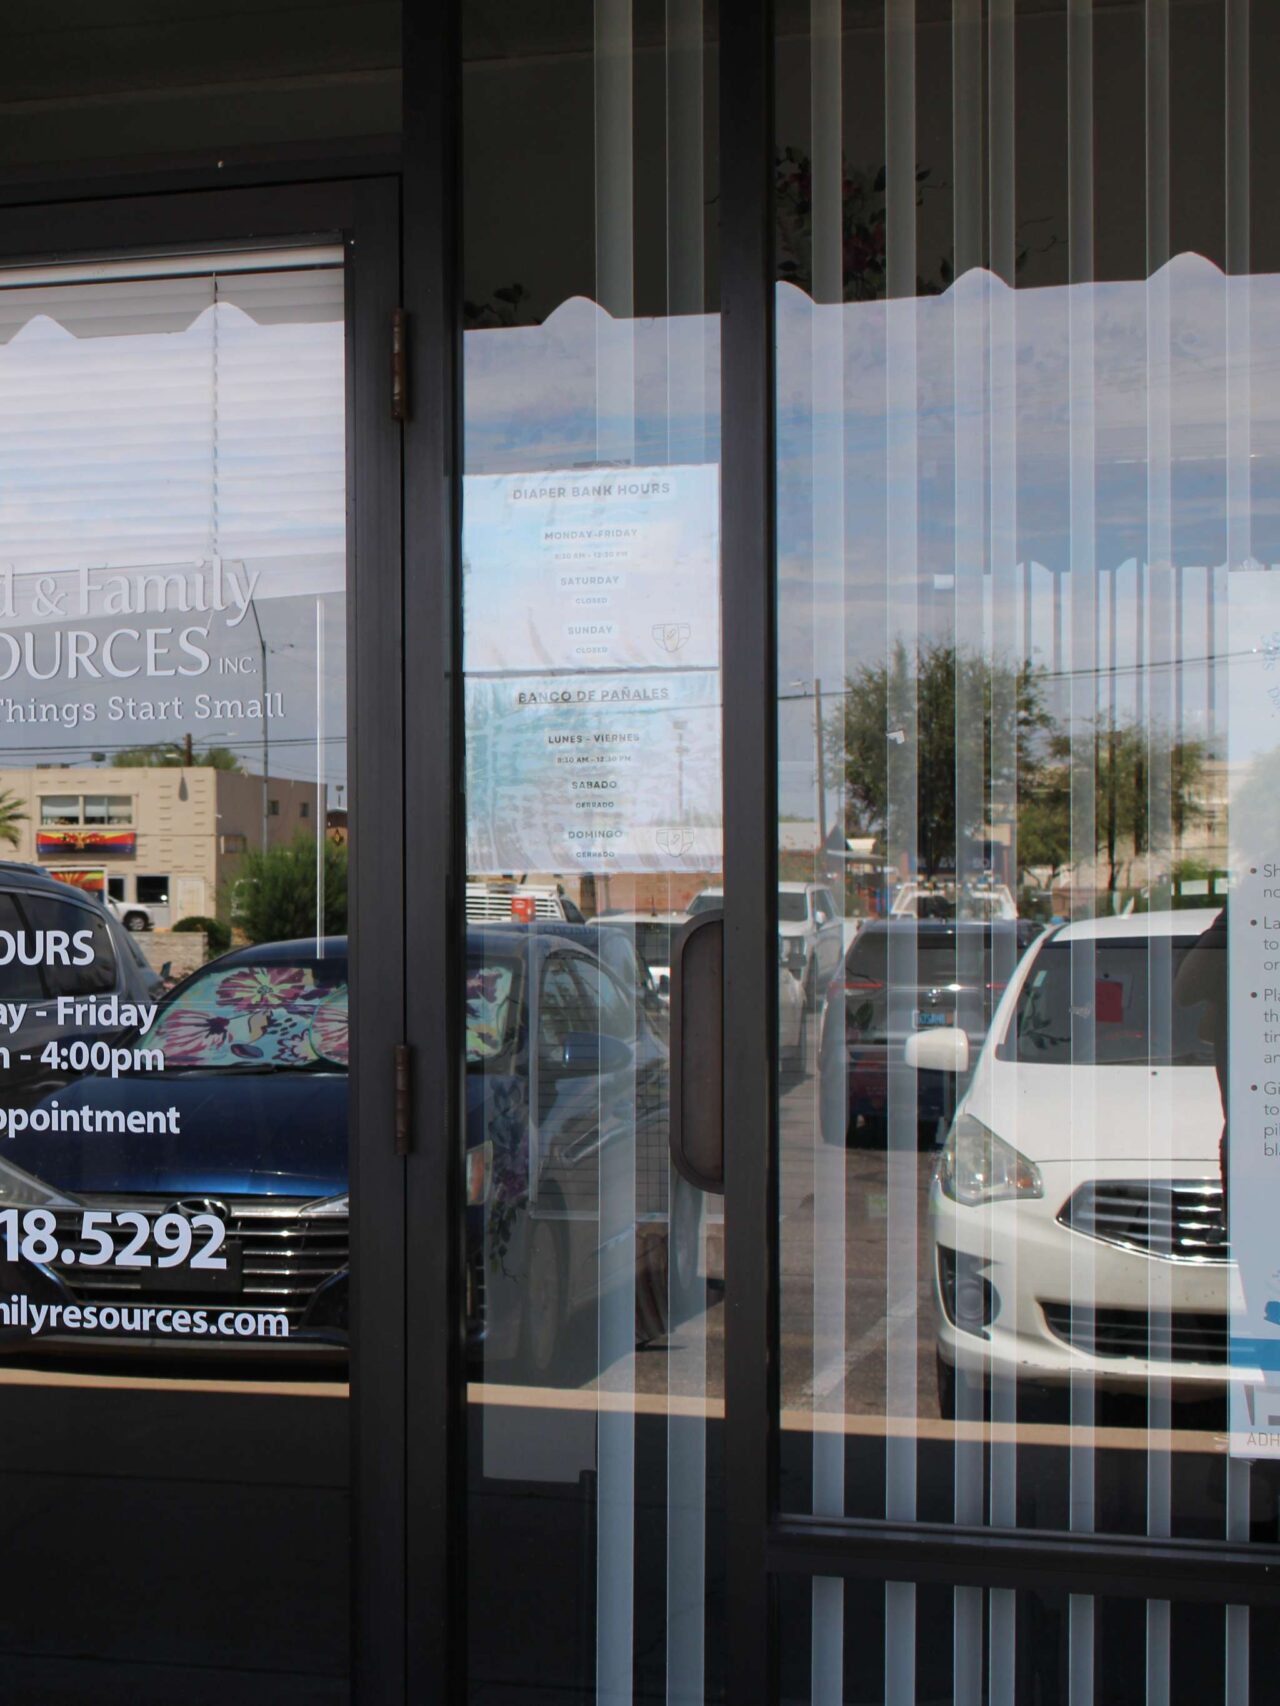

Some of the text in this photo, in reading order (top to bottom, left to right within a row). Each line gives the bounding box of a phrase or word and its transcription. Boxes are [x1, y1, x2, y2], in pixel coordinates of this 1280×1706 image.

[512, 483, 670, 500] DIAPER BANK HOURS
[544, 529, 638, 540] MONDAY-FRIDAY
[560, 575, 620, 586] SATURDAY
[31, 576, 66, 616] &
[78, 557, 262, 627] Family
[568, 626, 613, 635] SUNDAY
[219, 656, 257, 675] INC.
[519, 686, 669, 704] BANCO DE PAÑALES
[107, 695, 184, 721] Start
[194, 692, 286, 719] Small
[548, 733, 640, 744] LUNES VIERNES
[568, 830, 623, 839] DOMINGO
[1263, 939, 1280, 950] to
[55, 995, 157, 1034] Friday
[40, 1041, 165, 1078] 4:00pm
[1264, 1104, 1280, 1116] to
